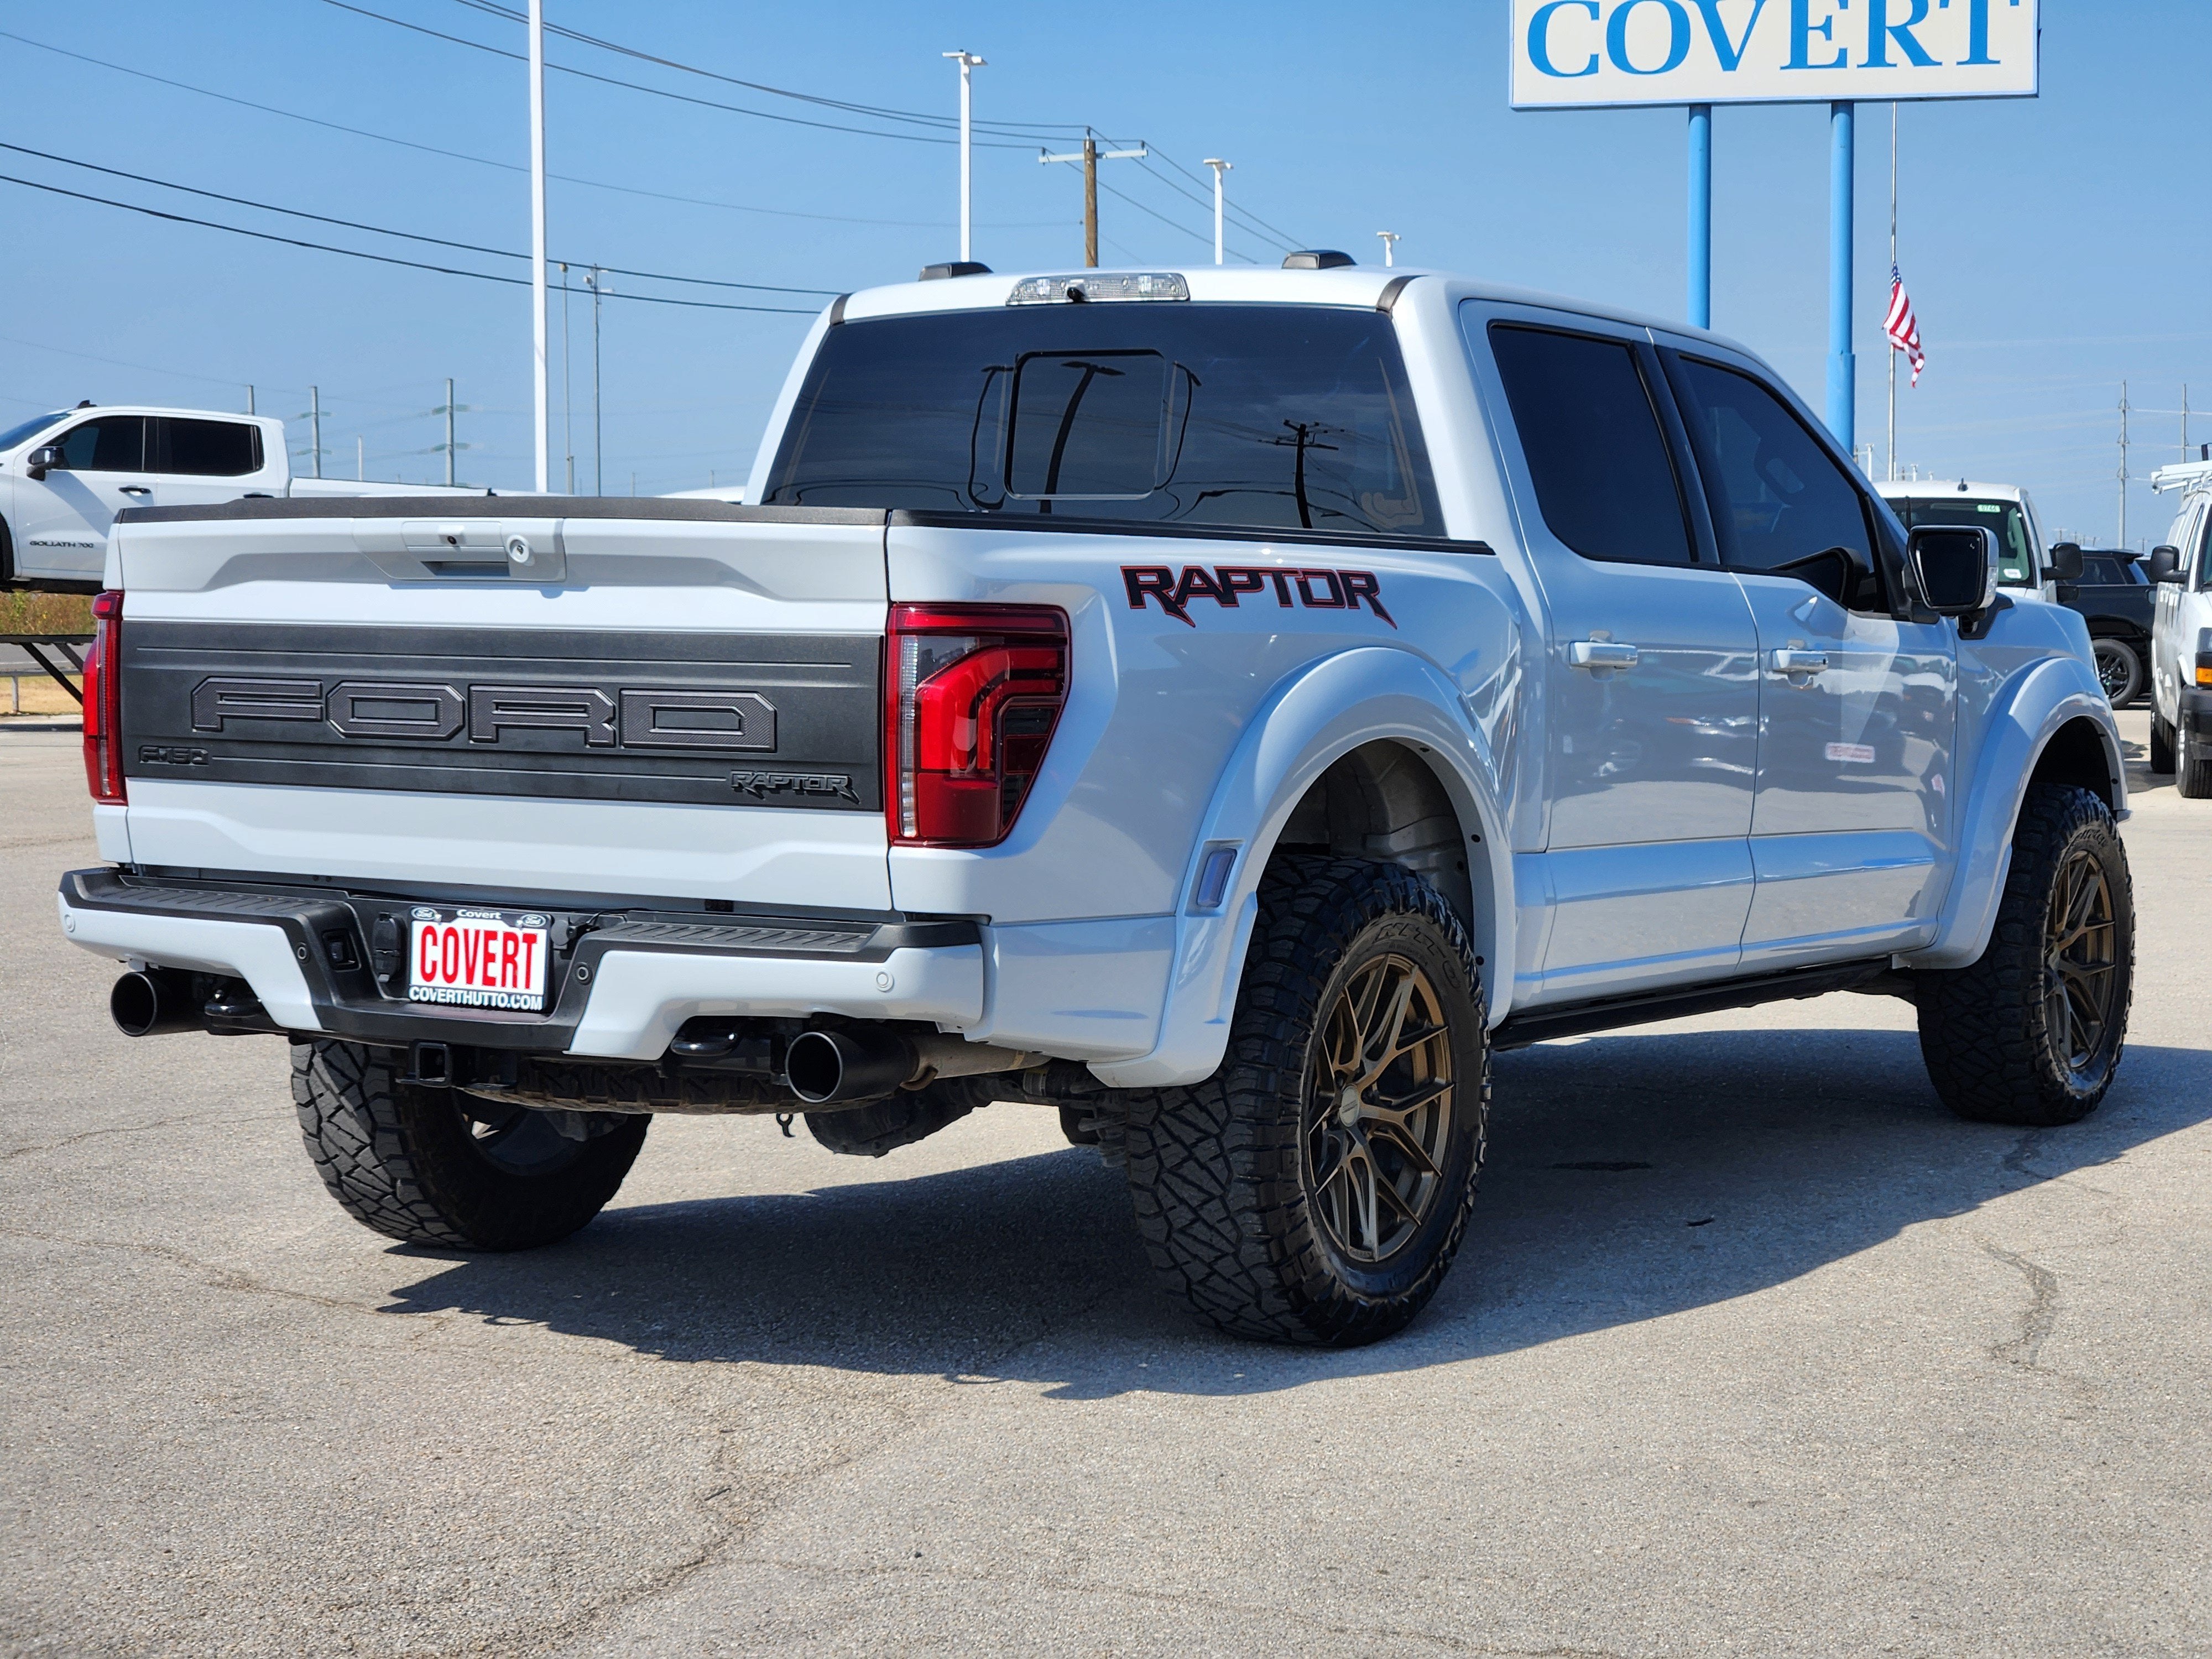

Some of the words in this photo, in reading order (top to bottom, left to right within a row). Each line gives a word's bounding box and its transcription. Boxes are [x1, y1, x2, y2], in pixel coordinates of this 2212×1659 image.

[1527, 0, 2020, 77] COVERT
[1120, 565, 1397, 629] RAPTOR
[191, 676, 777, 753] FORD
[731, 770, 860, 805] RAPTOR
[456, 909, 502, 919] Covert
[420, 925, 538, 989] COVERT
[409, 987, 542, 1010] COVERTHUTTO.COM
